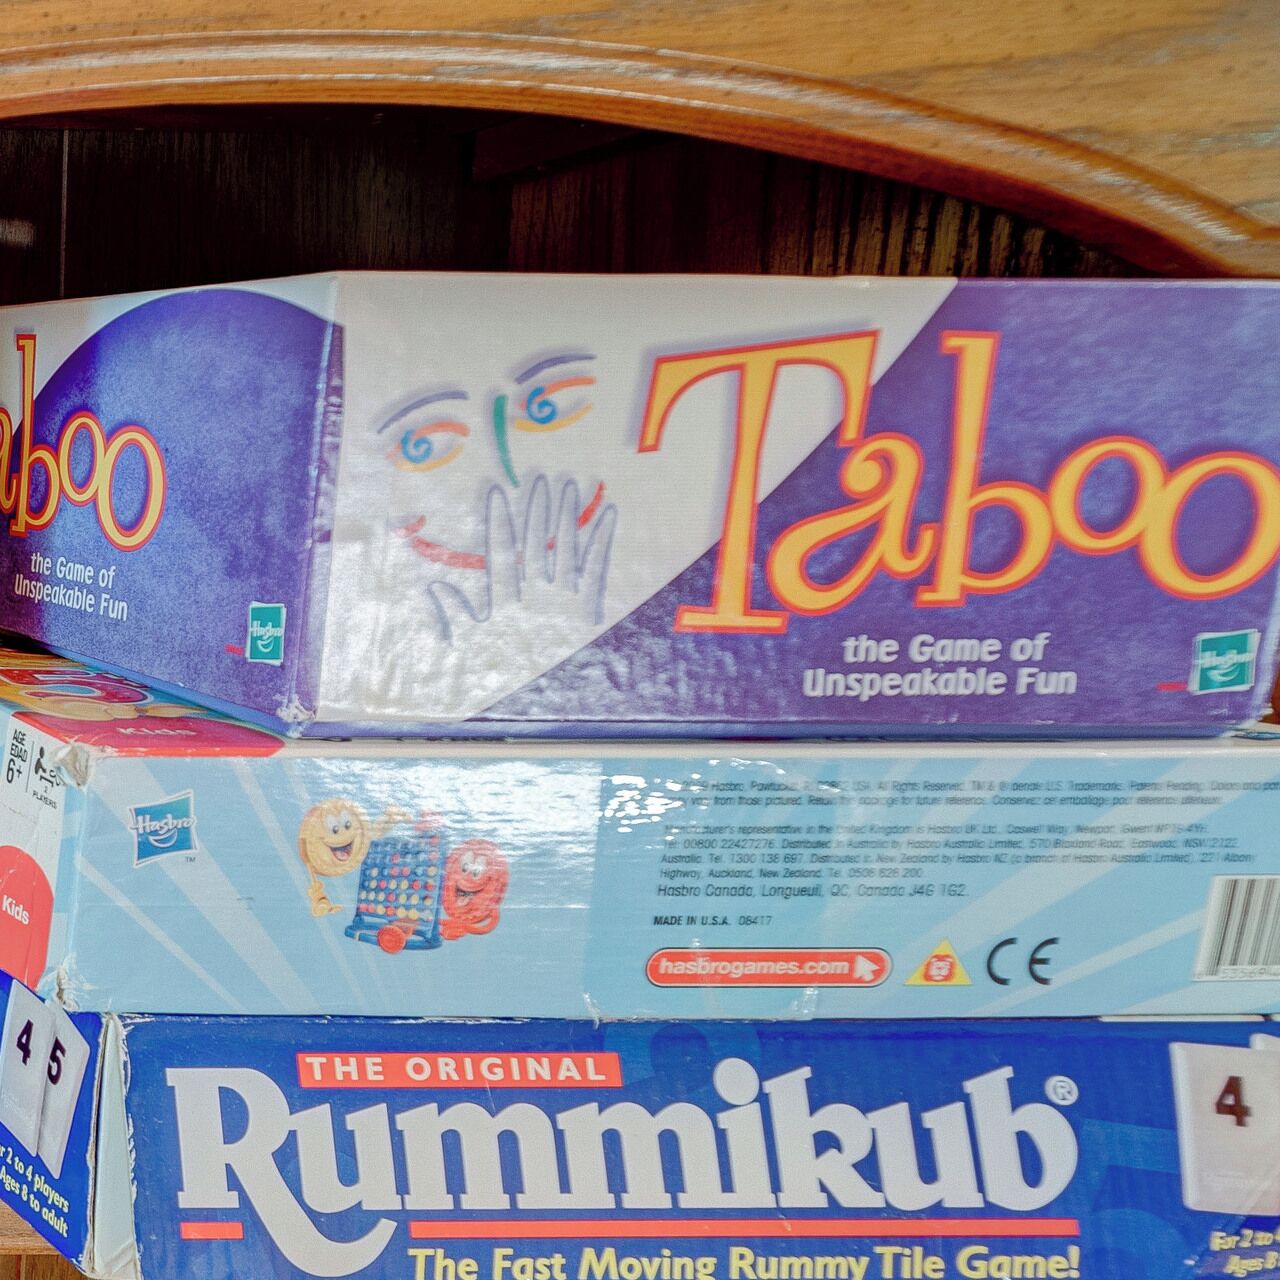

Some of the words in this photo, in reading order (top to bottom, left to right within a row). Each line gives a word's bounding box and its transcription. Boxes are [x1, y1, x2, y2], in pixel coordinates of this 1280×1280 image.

[636, 328, 1280, 634] Taboo
[31, 552, 51, 575] the
[56, 557, 94, 584] Game
[99, 566, 117, 590] of
[14, 574, 95, 612] Unspeakable
[99, 593, 129, 621] Fun
[251, 621, 284, 638] Hasbro
[842, 633, 899, 664] the
[908, 633, 1001, 664] Game
[1009, 631, 1052, 662] of
[802, 668, 1007, 702] Unspeakable
[1016, 667, 1078, 696] Fun
[129, 811, 196, 835] Hasbro
[1, 894, 30, 925] Kids
[653, 915, 683, 926] MADE
[686, 915, 697, 926] IN
[659, 956, 850, 980] hasbrogames.com
[987, 937, 1059, 985] CE
[16, 1018, 33, 1067] 4
[47, 1036, 66, 1086] 5
[305, 1055, 385, 1082] THE
[404, 1055, 607, 1082] ORIGINAL
[1215, 1075, 1254, 1128] 4
[6, 1146, 13, 1164] 2
[14, 1156, 25, 1175] to
[26, 1164, 33, 1181] 4
[34, 1173, 70, 1213] players
[0, 1165, 20, 1195] Ages
[21, 1183, 28, 1202] 8
[29, 1193, 40, 1213] to
[41, 1206, 69, 1238] adult
[874, 1246, 946, 1280] Tile
[956, 1246, 1080, 1280] Game!
